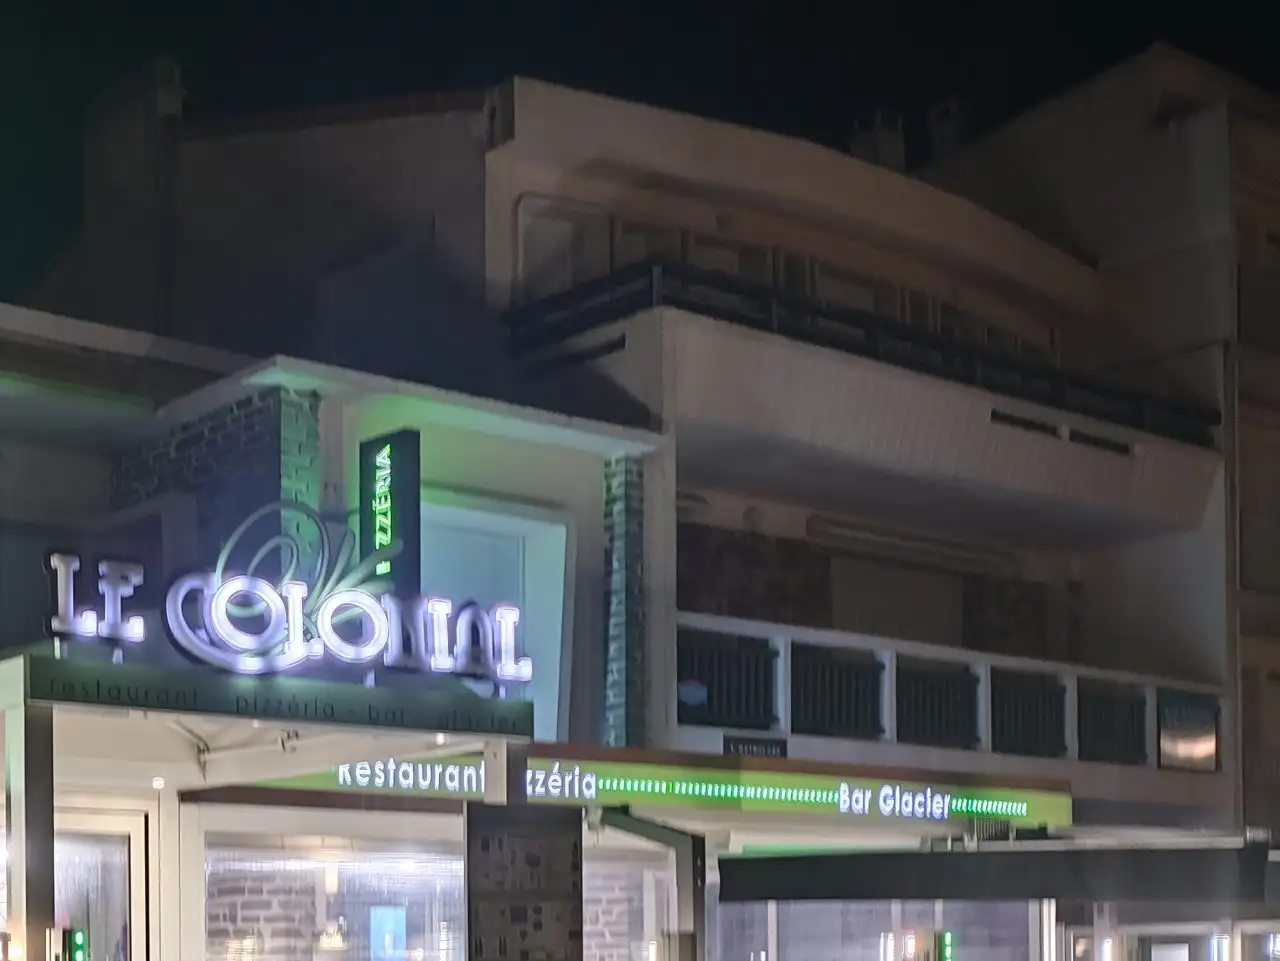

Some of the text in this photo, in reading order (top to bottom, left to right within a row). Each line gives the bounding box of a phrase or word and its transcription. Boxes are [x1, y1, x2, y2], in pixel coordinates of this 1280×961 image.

[48, 552, 144, 642] LE
[526, 761, 596, 799] zzéria
[838, 781, 952, 820] Bar Glacier
